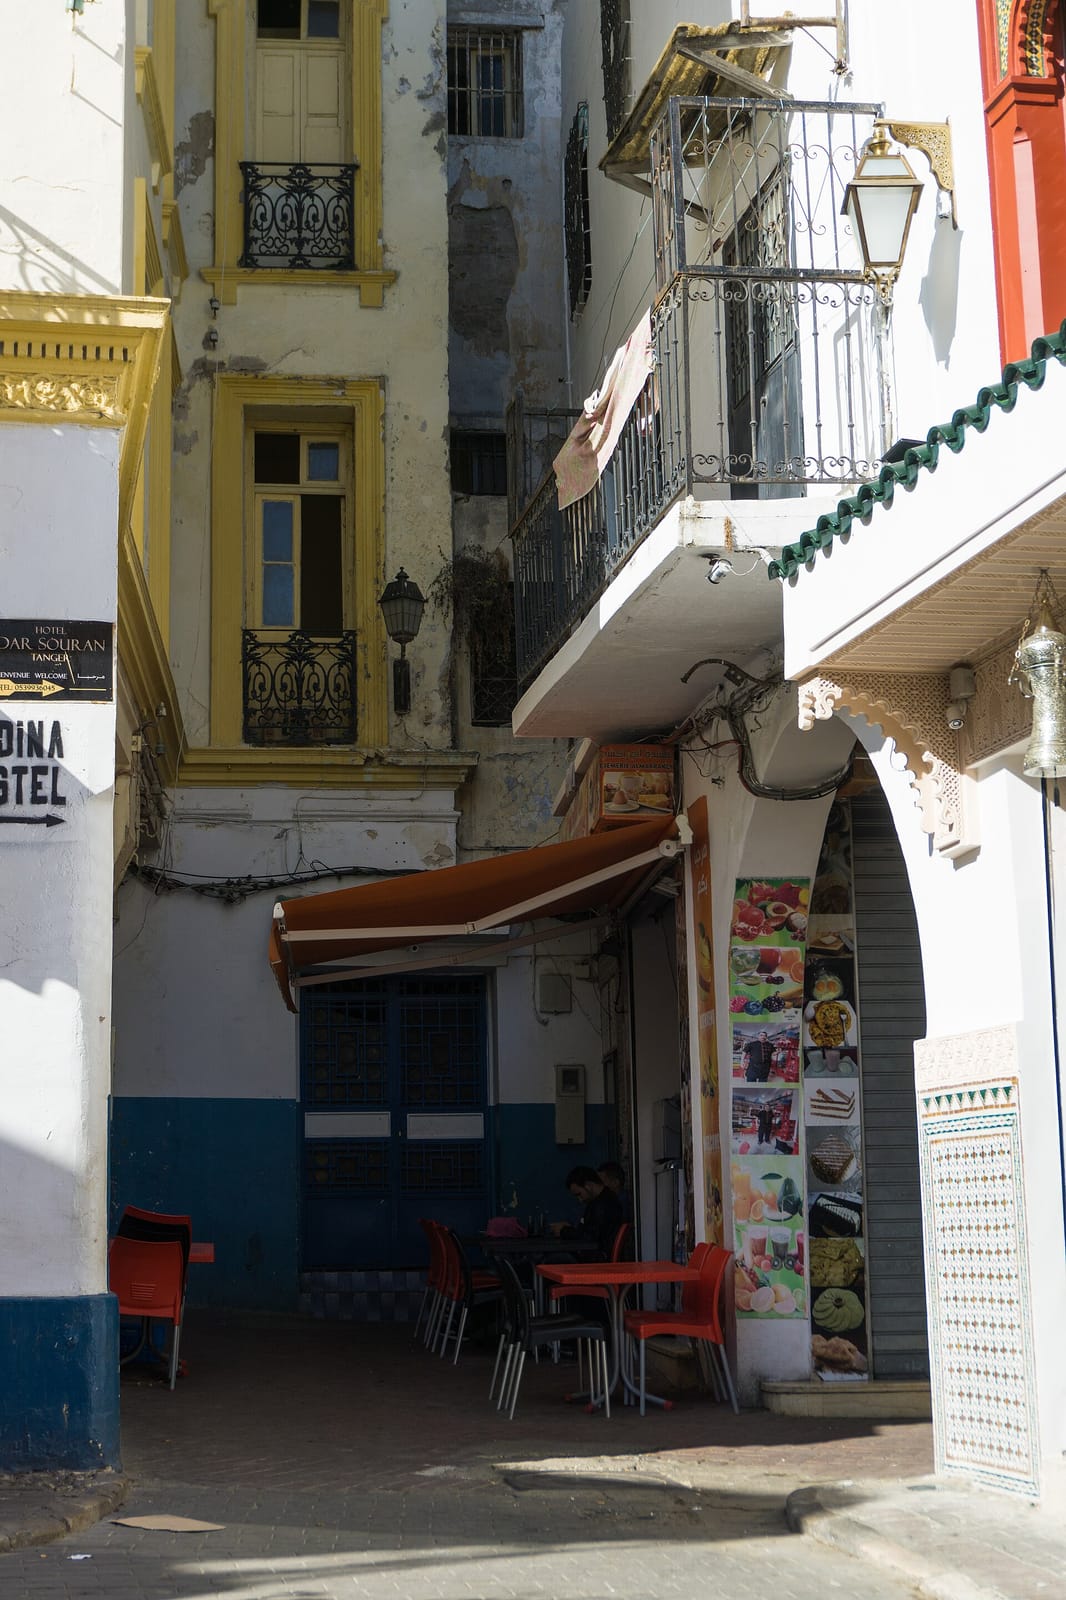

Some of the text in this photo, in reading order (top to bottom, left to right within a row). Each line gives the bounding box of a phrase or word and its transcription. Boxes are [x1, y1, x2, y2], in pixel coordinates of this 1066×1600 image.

[35, 625, 67, 635] HOTEL
[0, 636, 105, 652] DAR SOURAN
[31, 653, 69, 663] TANGER
[34, 671, 68, 680] WELCOME
